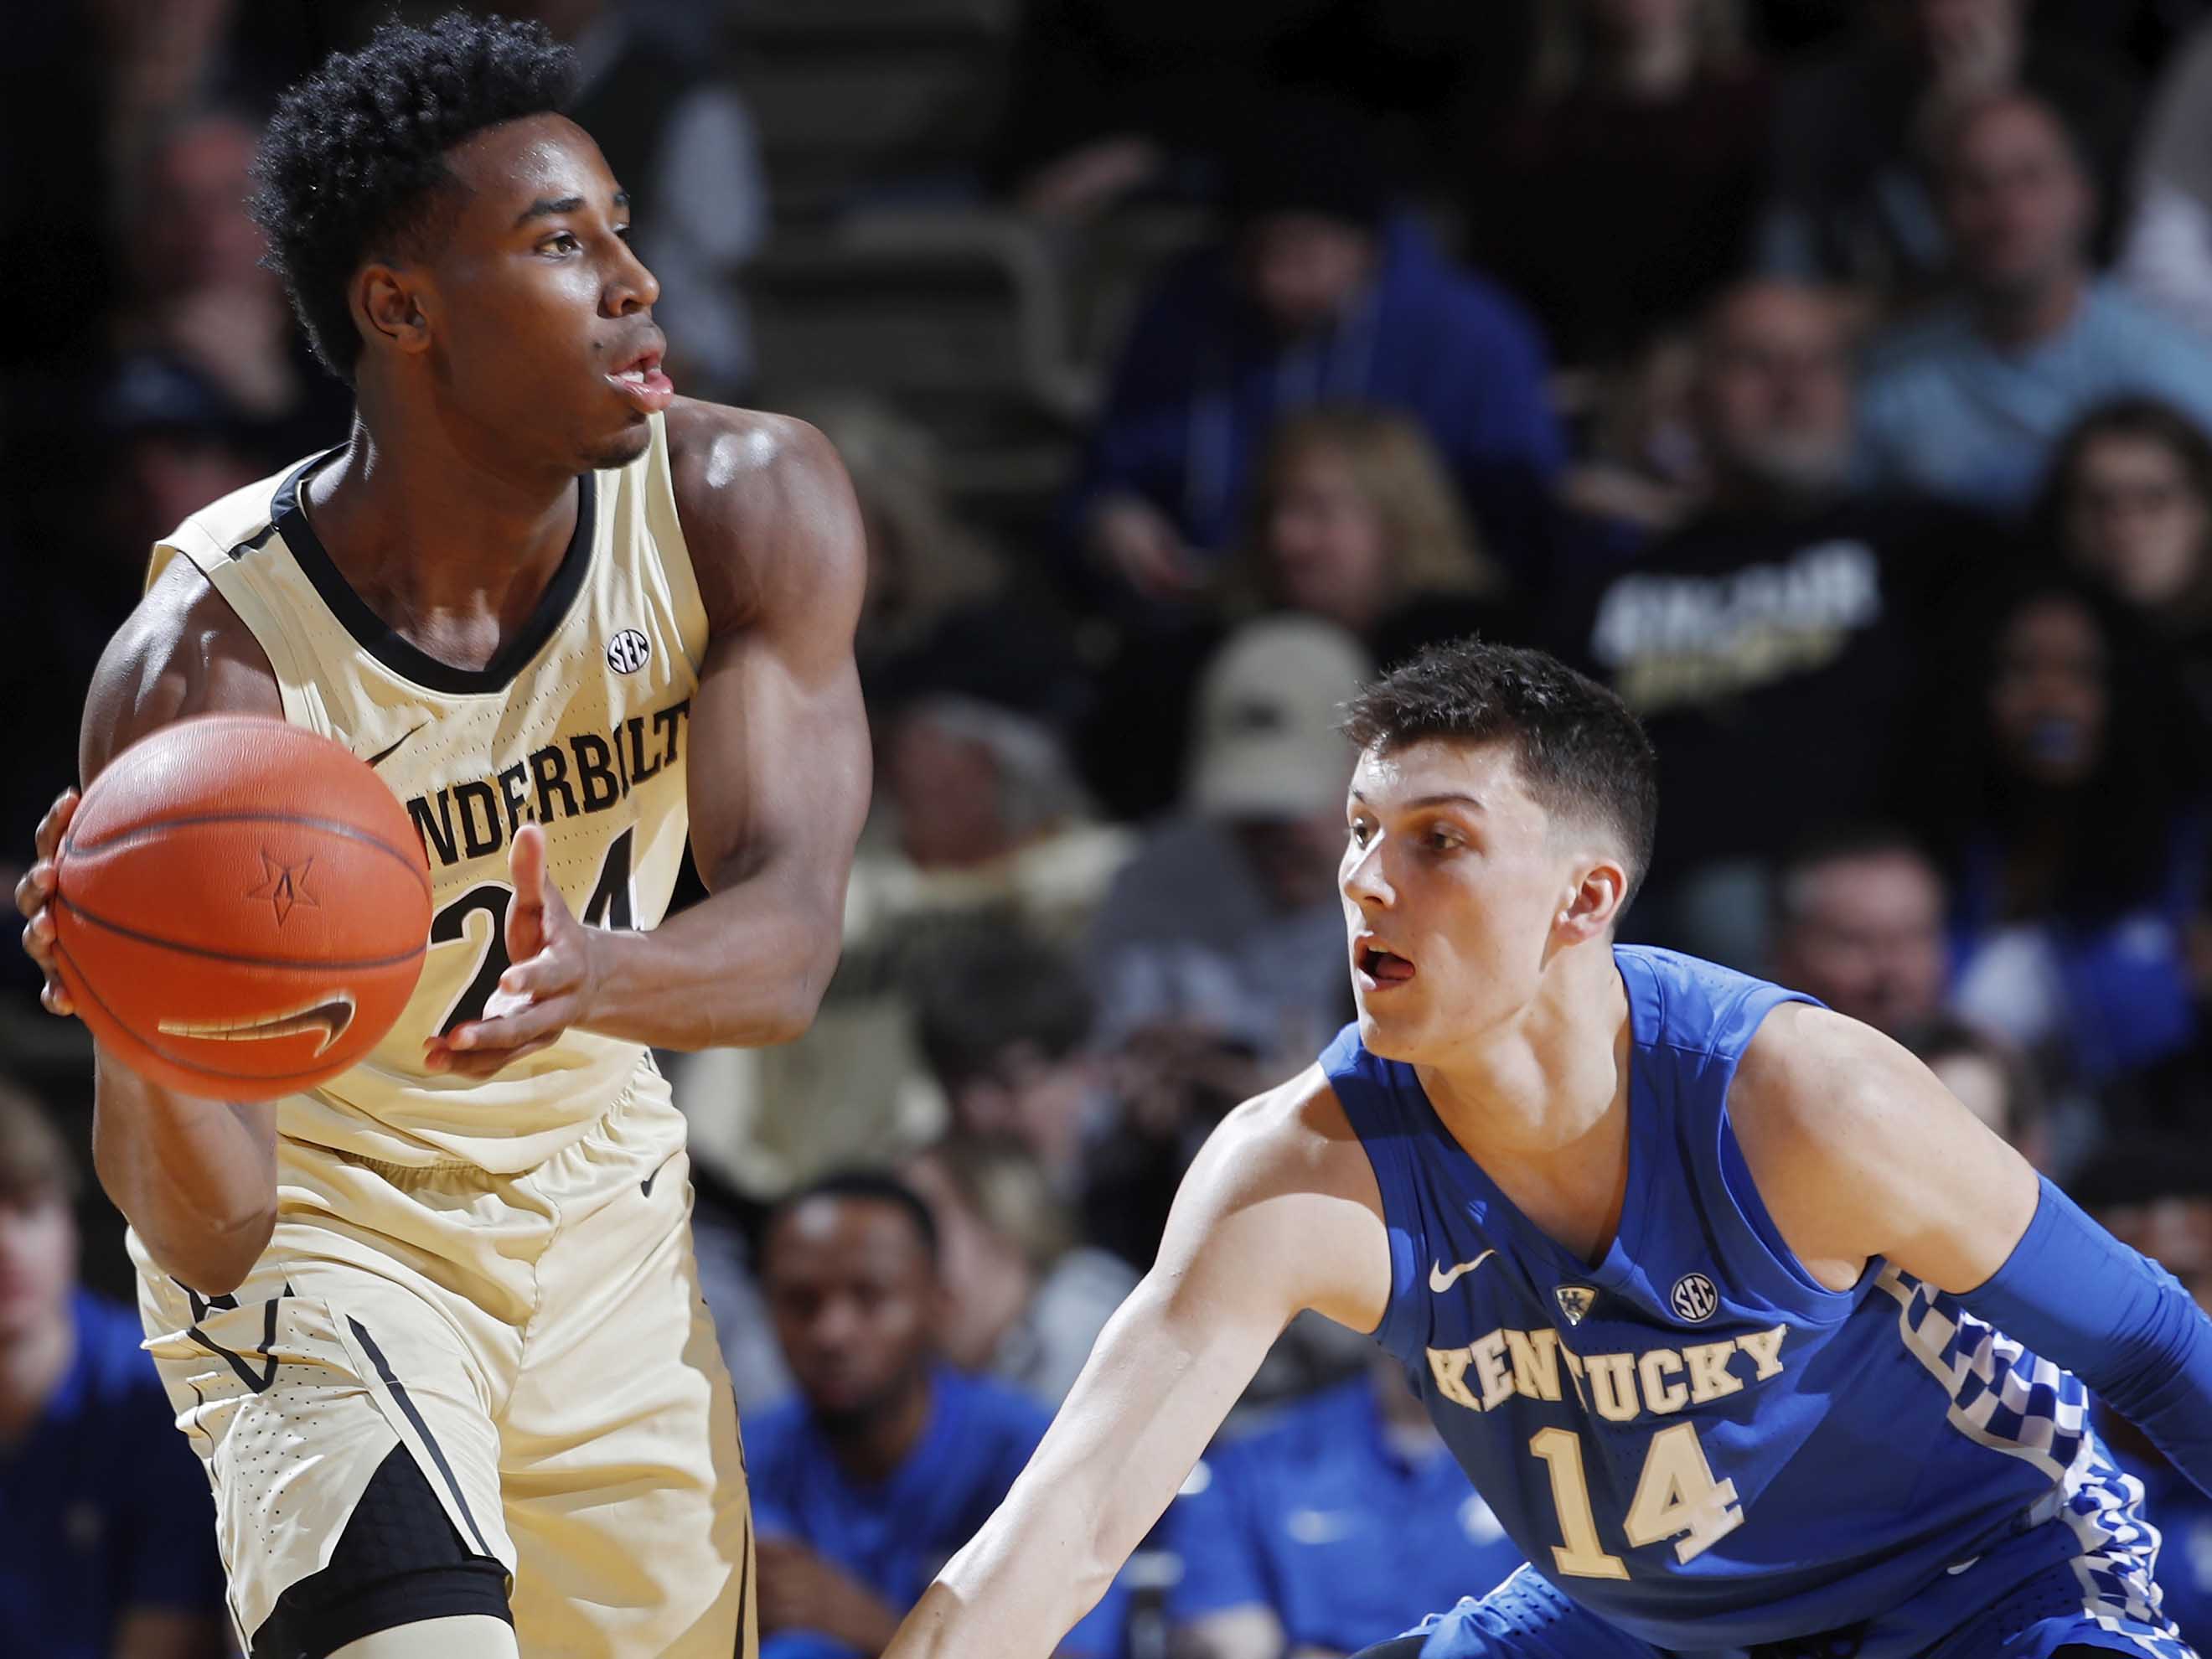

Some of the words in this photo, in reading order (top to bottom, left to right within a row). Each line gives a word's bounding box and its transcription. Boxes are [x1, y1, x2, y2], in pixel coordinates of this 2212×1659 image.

[607, 629, 649, 674] SEC
[407, 700, 690, 870] NDERBILT
[1672, 1274, 1717, 1321] SEC
[1529, 1422, 1744, 1580] 14
